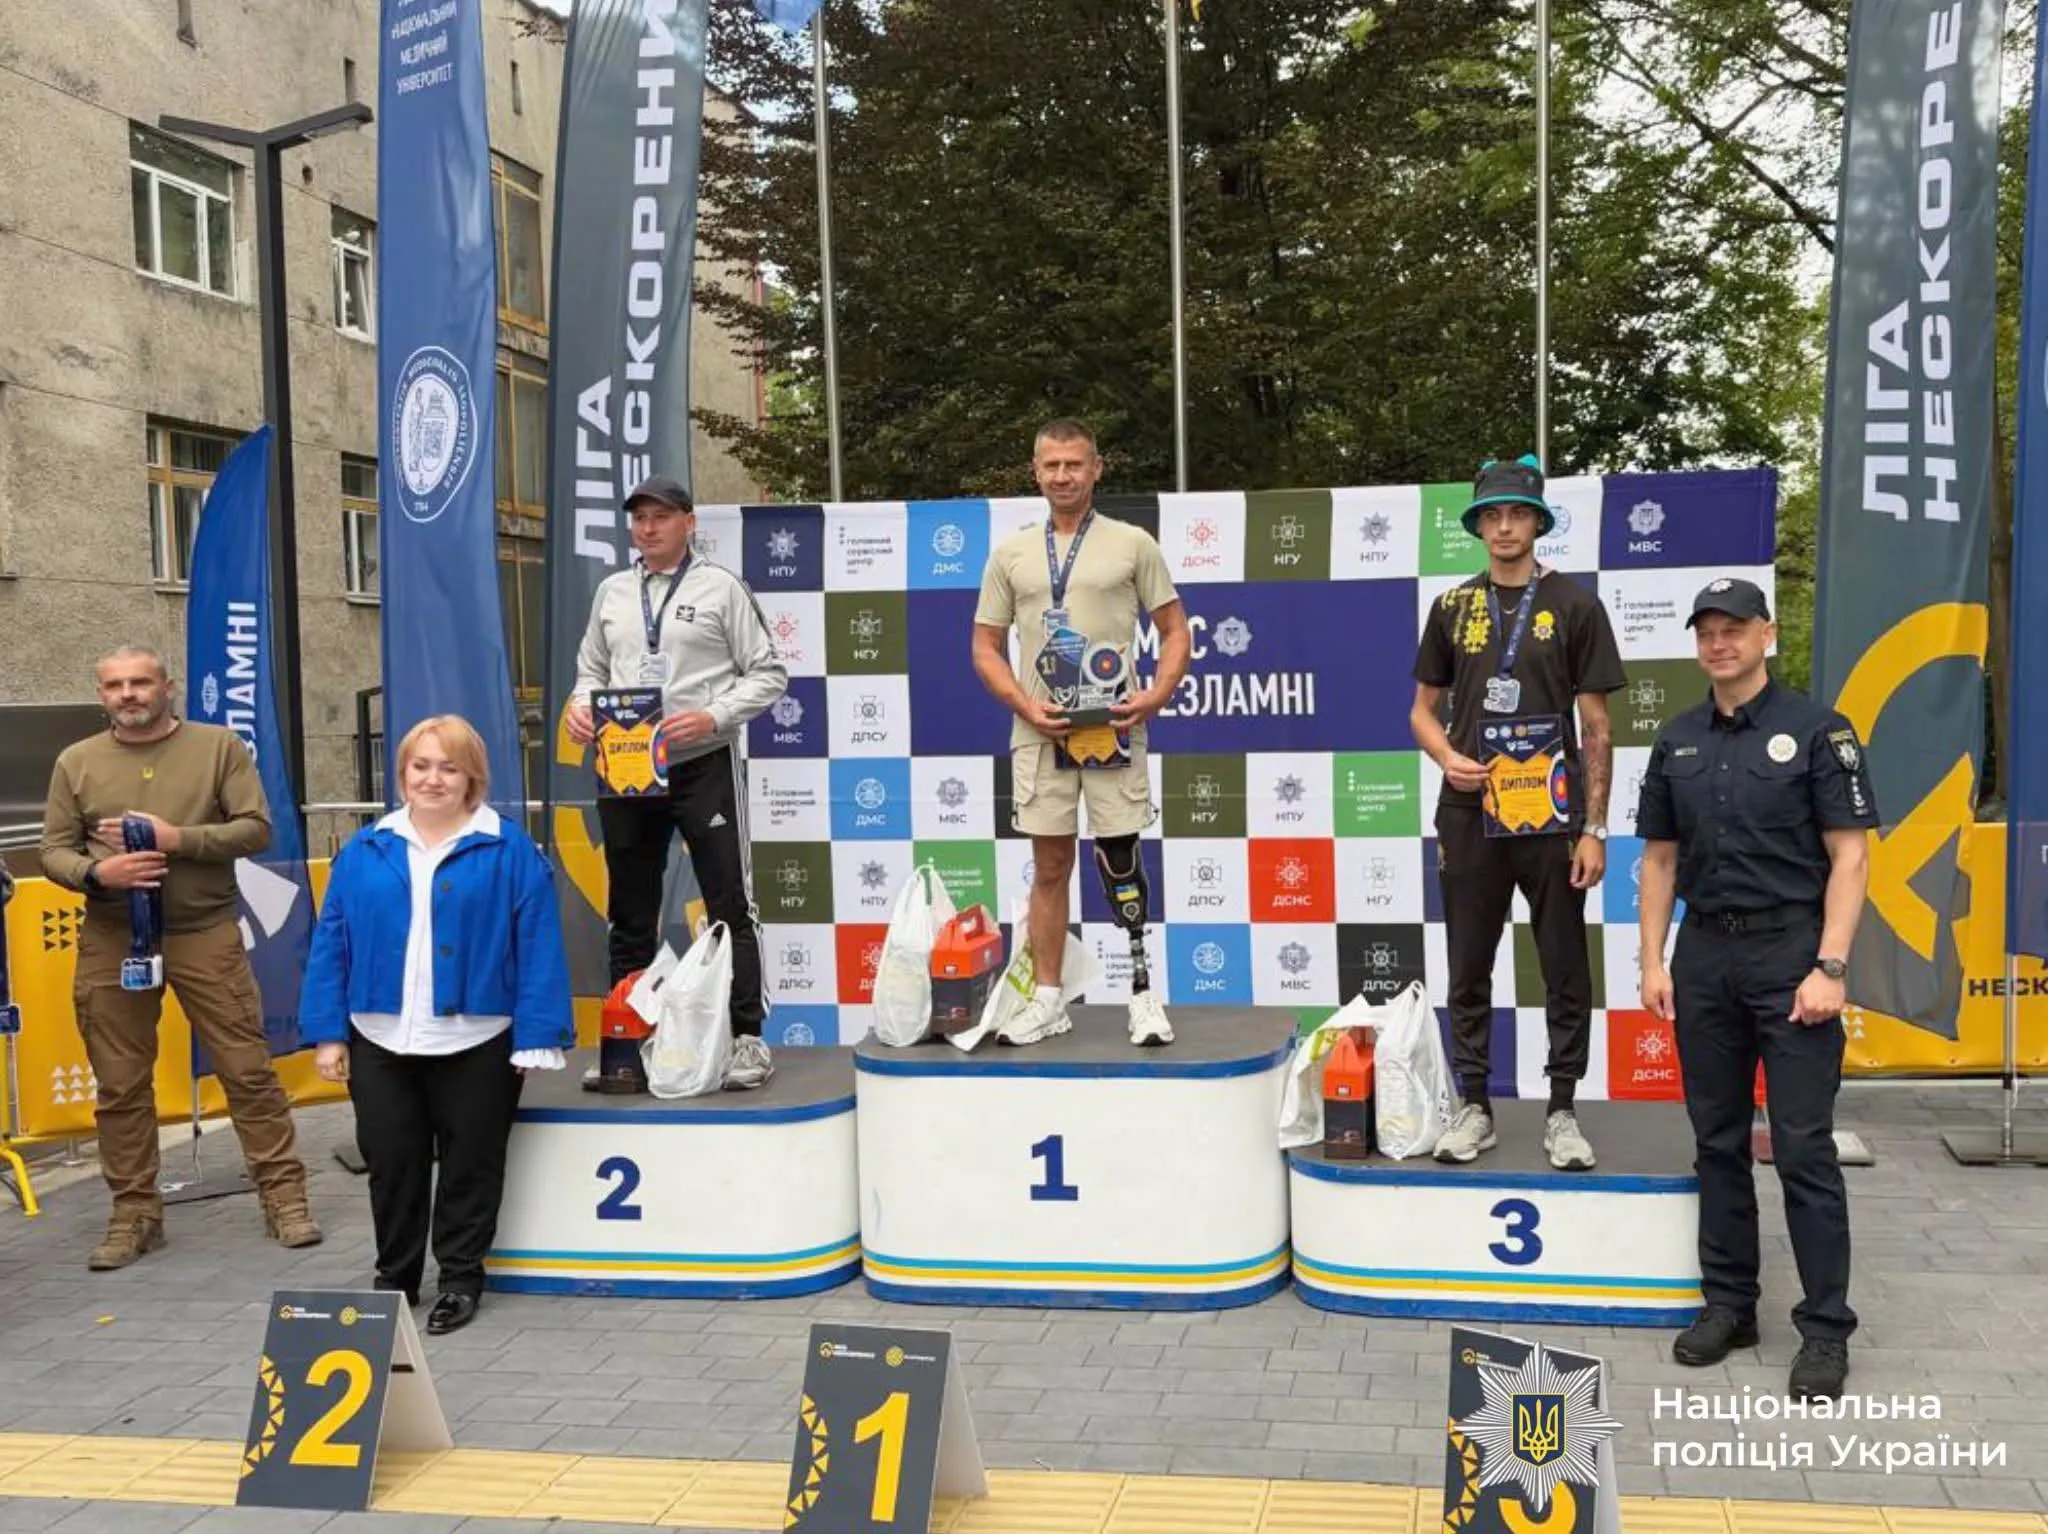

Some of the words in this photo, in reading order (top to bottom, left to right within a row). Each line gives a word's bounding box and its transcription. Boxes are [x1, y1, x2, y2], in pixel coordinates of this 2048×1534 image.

[1862, 299, 1910, 521] ЛІГА
[574, 376, 612, 566] ЛІГА
[1628, 541, 1662, 553] МВС
[1181, 555, 1221, 568] ДСНС
[1274, 553, 1302, 566] НГУ
[1360, 552, 1390, 563] НПУ
[768, 565, 797, 578] НПУ
[932, 562, 965, 576] ДМС
[1134, 616, 1208, 660] МС
[853, 649, 880, 661] НГУ
[1137, 673, 1315, 717] ЗЛАМНІ
[773, 731, 803, 744] МВС
[851, 731, 887, 745] ДПСУ
[1500, 776, 1547, 791] ДИПЛОМ
[855, 814, 887, 827] ДМС
[939, 814, 968, 825] МВС
[1191, 812, 1218, 824] НГУ
[1276, 812, 1305, 822] НПУ
[780, 897, 805, 908] НГУ
[861, 896, 888, 907] НПУ
[1188, 895, 1226, 907] ДПСУ
[1272, 895, 1312, 907] ДСНС
[1366, 895, 1393, 906] НГУ
[778, 978, 815, 991] ДПСУ
[1194, 979, 1228, 992] ДМС
[1280, 980, 1312, 990] МВС
[1362, 980, 1401, 992] ДПСУ
[1631, 1068, 1676, 1081] ДСНС
[1030, 1135, 1079, 1201] 1
[596, 1156, 642, 1220] 2
[1488, 1198, 1543, 1266] 3
[289, 1349, 373, 1468] 2
[854, 1392, 910, 1522] 1
